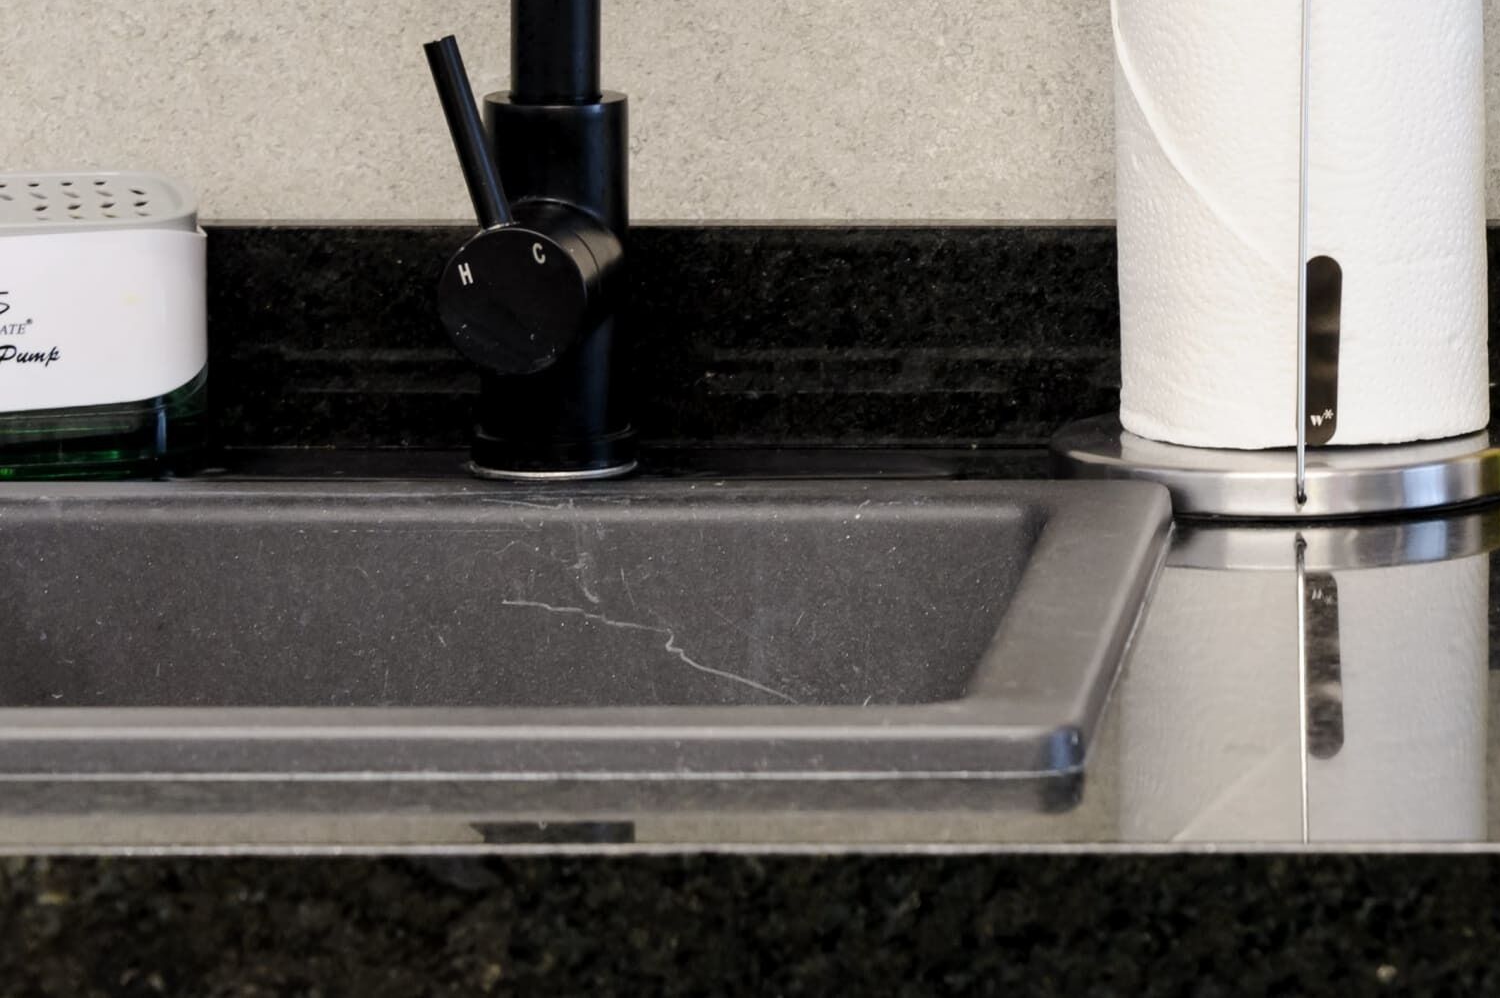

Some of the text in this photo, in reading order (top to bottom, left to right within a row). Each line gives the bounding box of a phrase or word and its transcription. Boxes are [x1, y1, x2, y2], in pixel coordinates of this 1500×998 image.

[532, 242, 546, 264] C
[458, 262, 474, 286] H
[0, 344, 61, 368] Pump
